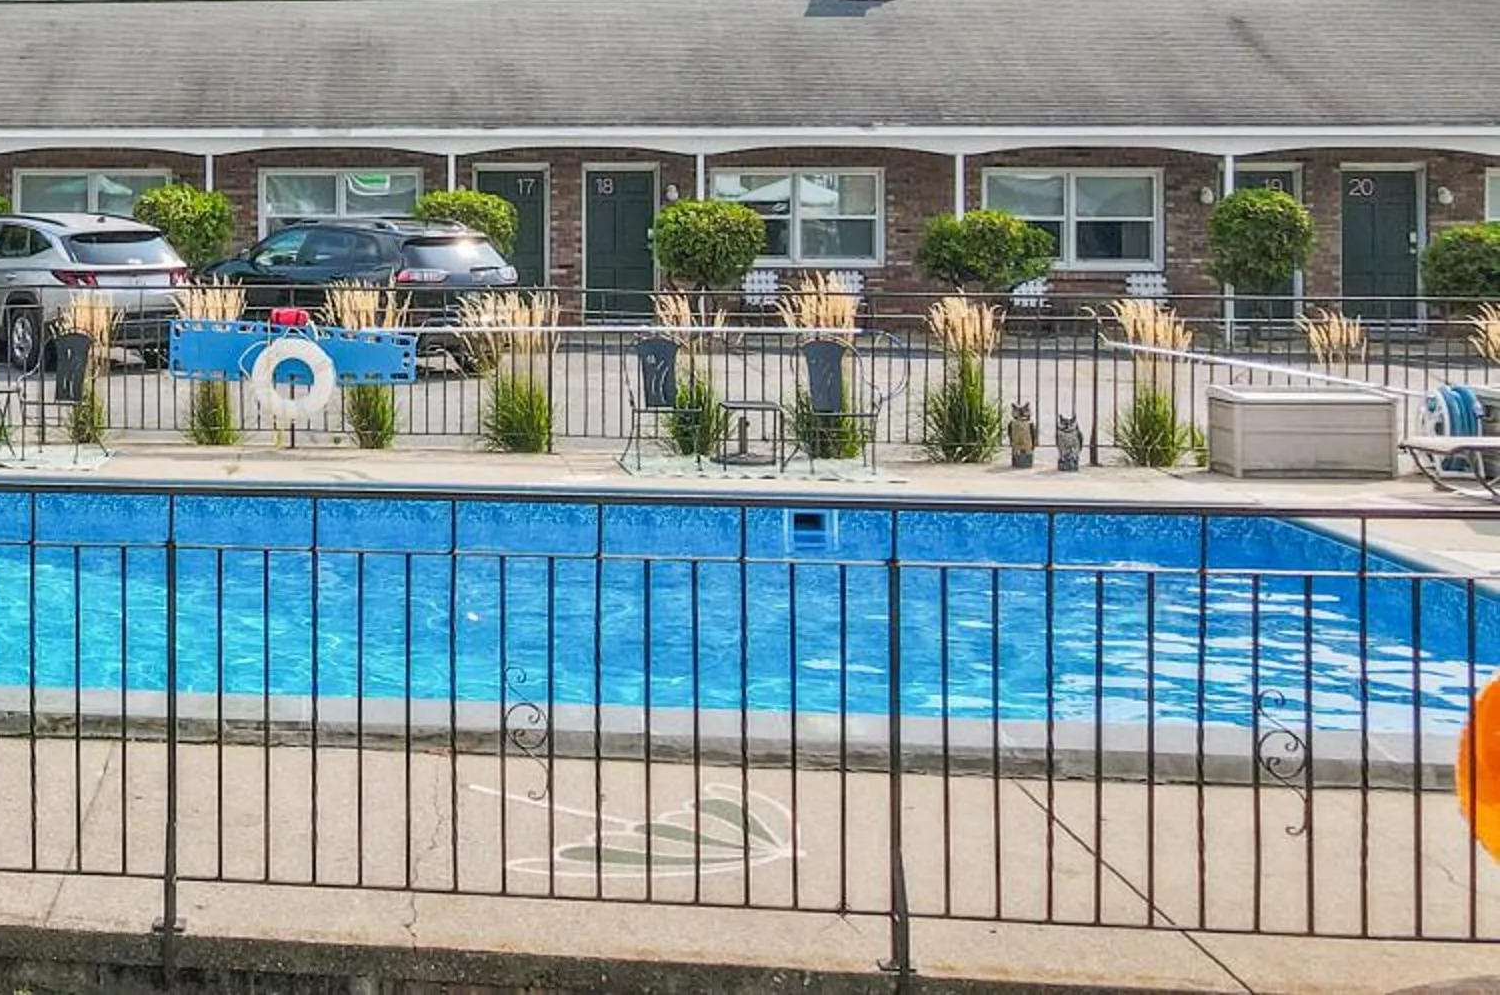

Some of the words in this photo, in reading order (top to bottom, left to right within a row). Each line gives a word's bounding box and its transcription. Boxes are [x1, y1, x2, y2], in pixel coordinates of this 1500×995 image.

[516, 178, 536, 194] 17
[596, 178, 613, 194] 18
[1348, 178, 1373, 195] 20
